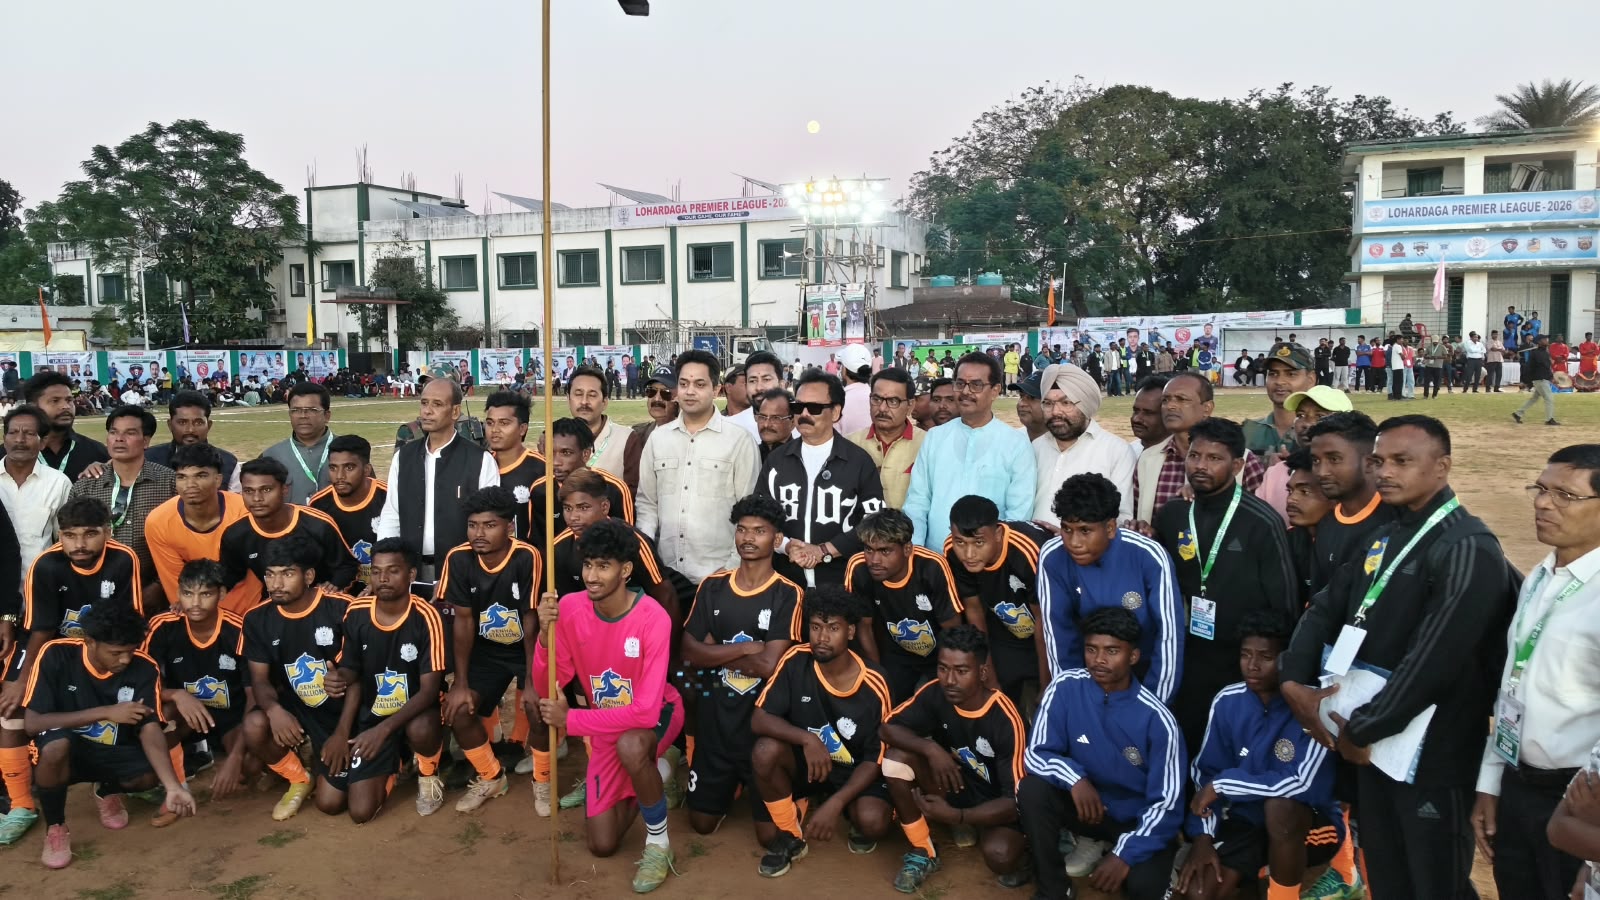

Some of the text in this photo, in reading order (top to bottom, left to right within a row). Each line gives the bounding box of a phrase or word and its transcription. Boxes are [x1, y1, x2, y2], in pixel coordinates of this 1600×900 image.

[635, 204, 688, 217] LOHARDAGA
[690, 201, 729, 214] PREMIER
[1388, 205, 1449, 218] LOHARDAGA
[1452, 203, 1497, 215] PREMIER
[298, 688, 325, 697] STALLION
[594, 774, 601, 800] 1
